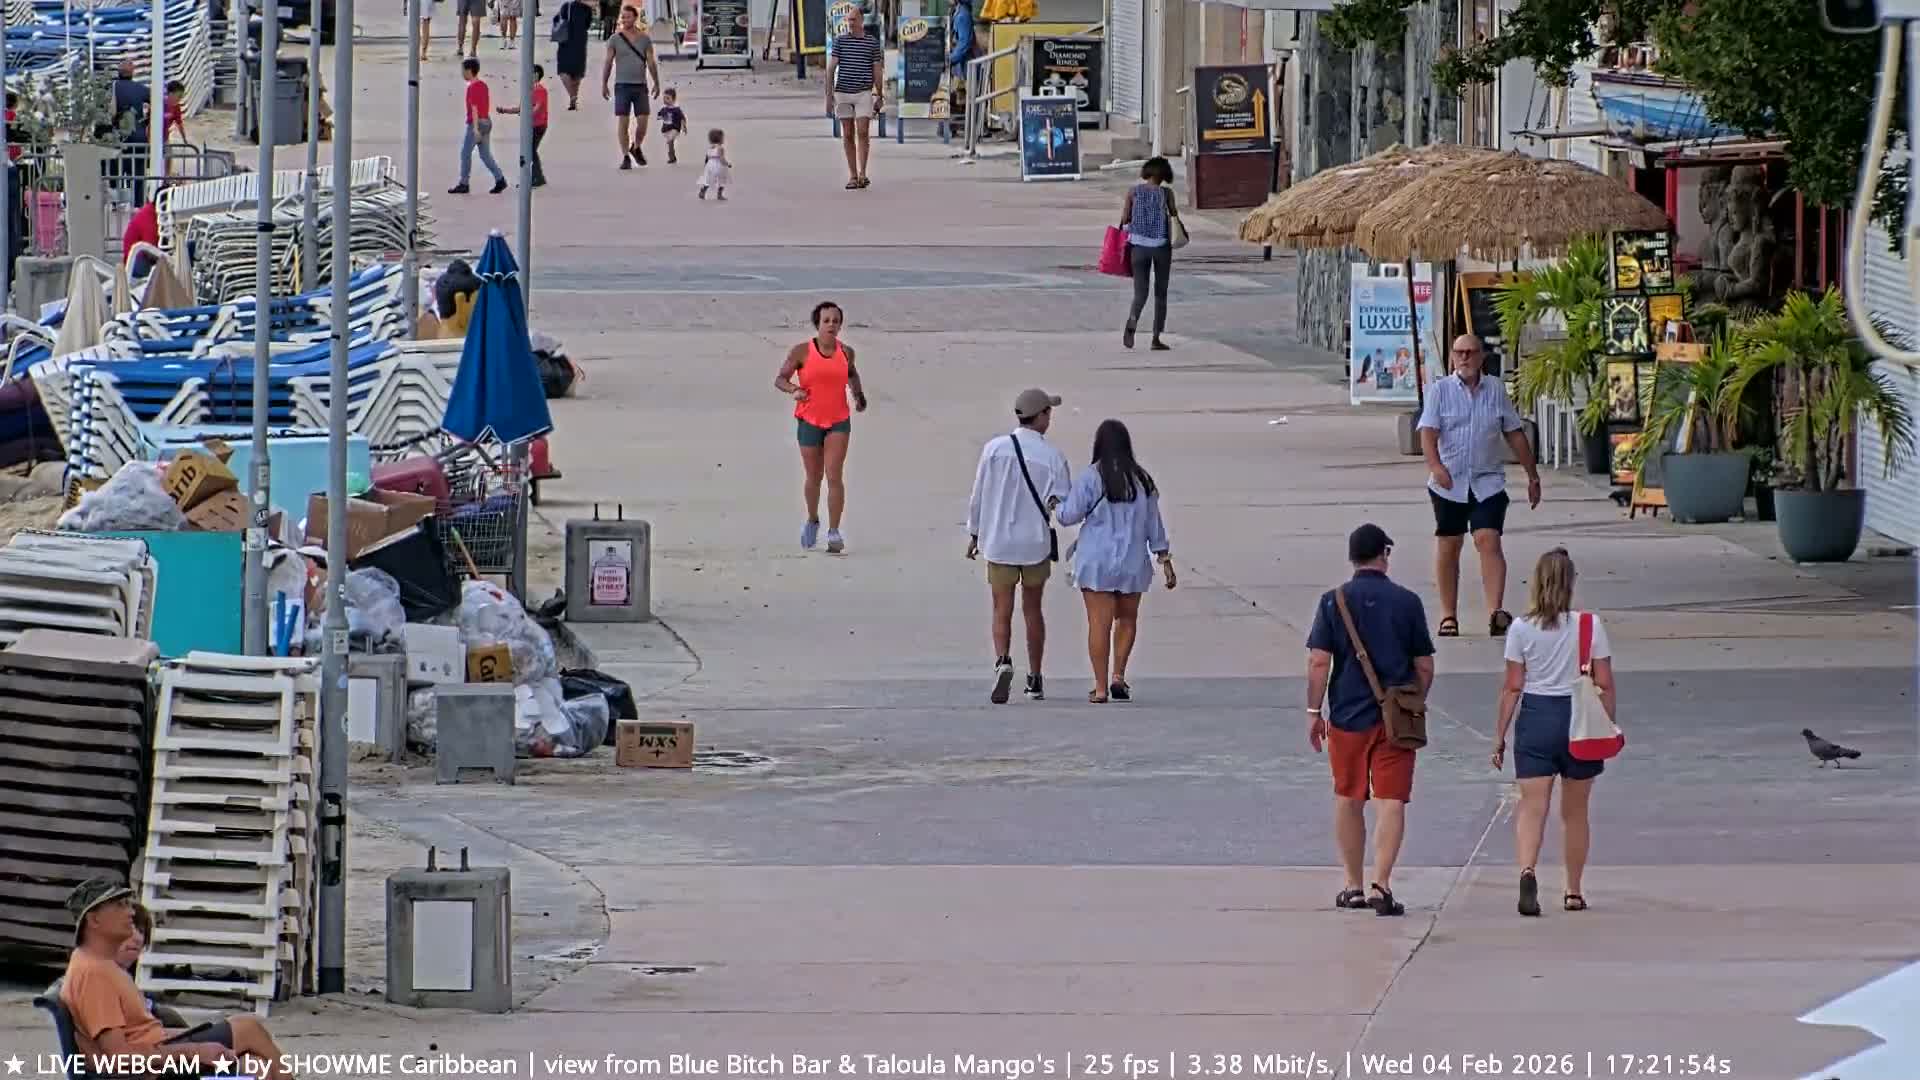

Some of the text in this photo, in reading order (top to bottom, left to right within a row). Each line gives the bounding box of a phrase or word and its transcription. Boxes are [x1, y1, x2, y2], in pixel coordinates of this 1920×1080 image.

[1049, 51, 1087, 60] DIAMOND
[1414, 285, 1432, 296] REE
[1359, 314, 1425, 330] LUXURY
[169, 465, 197, 504] rib
[639, 735, 679, 748] SXM
